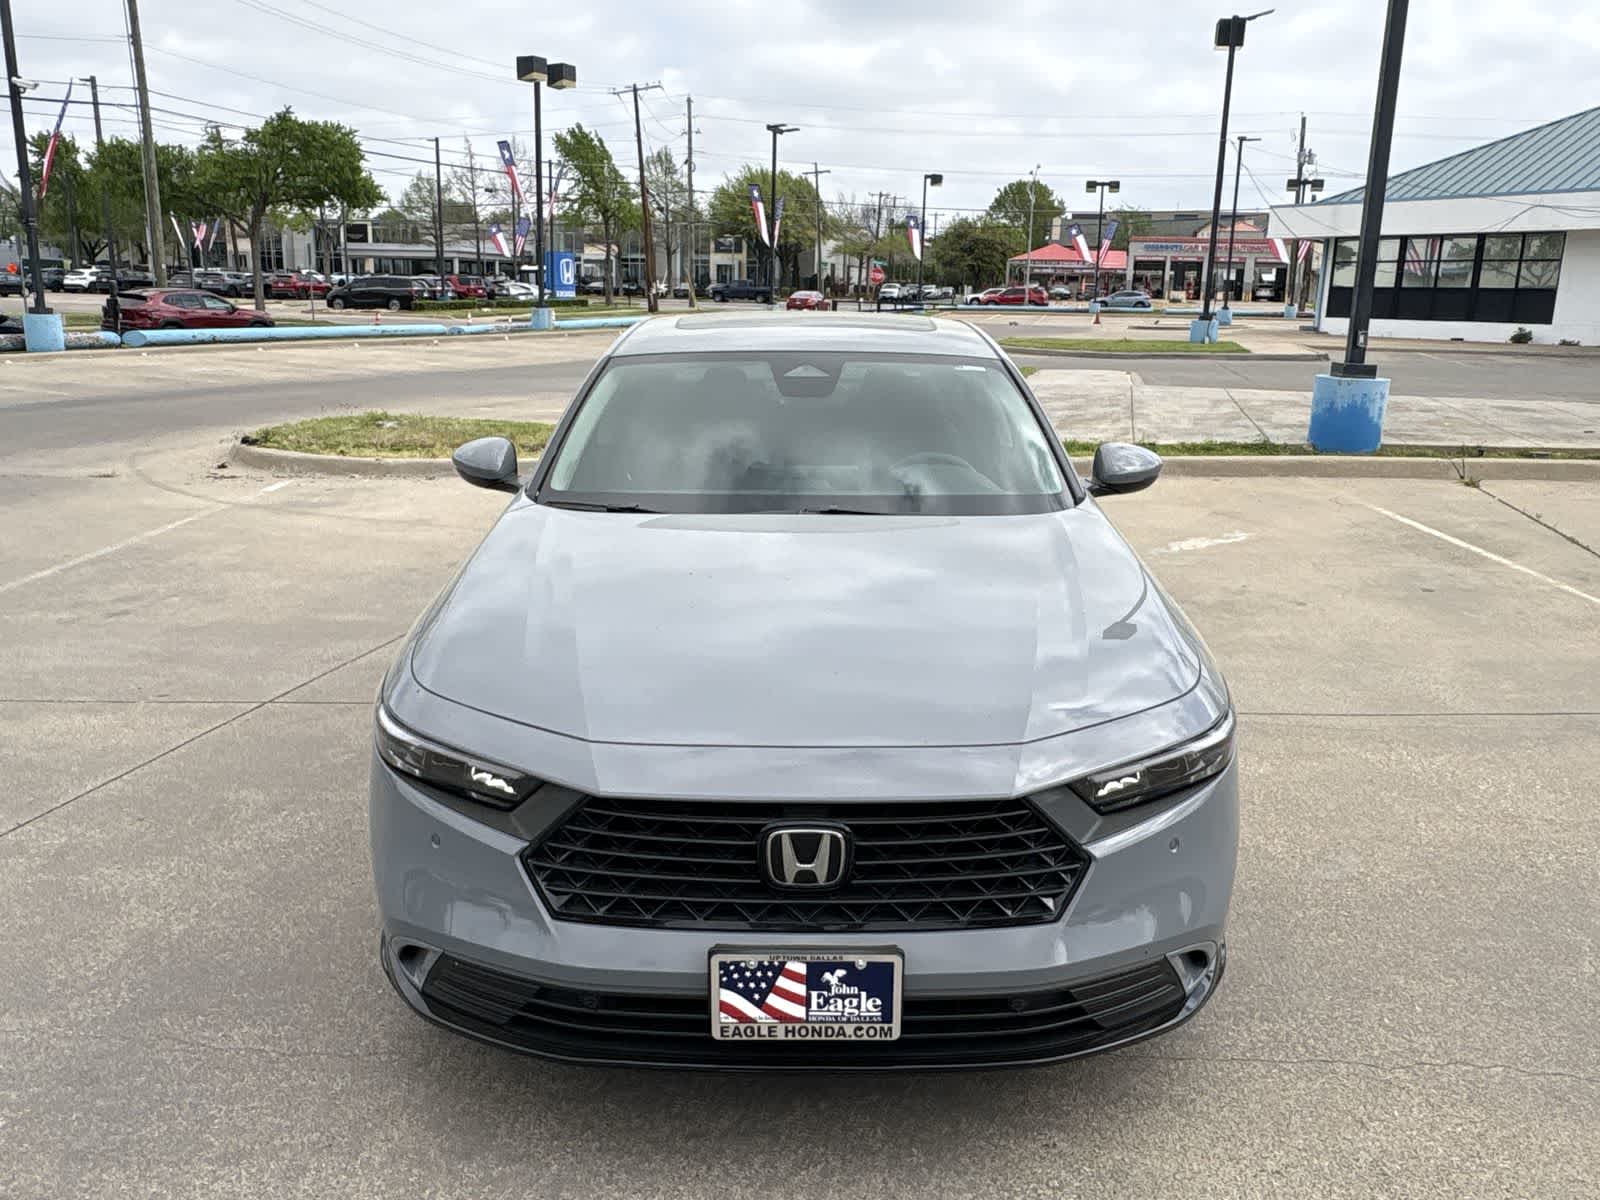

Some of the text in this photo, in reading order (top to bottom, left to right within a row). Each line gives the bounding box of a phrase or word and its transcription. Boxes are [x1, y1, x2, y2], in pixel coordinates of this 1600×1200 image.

[829, 985, 859, 996] John
[808, 991, 883, 1016] Eagle
[719, 1025, 894, 1039] EAGLE HONDA.COM
